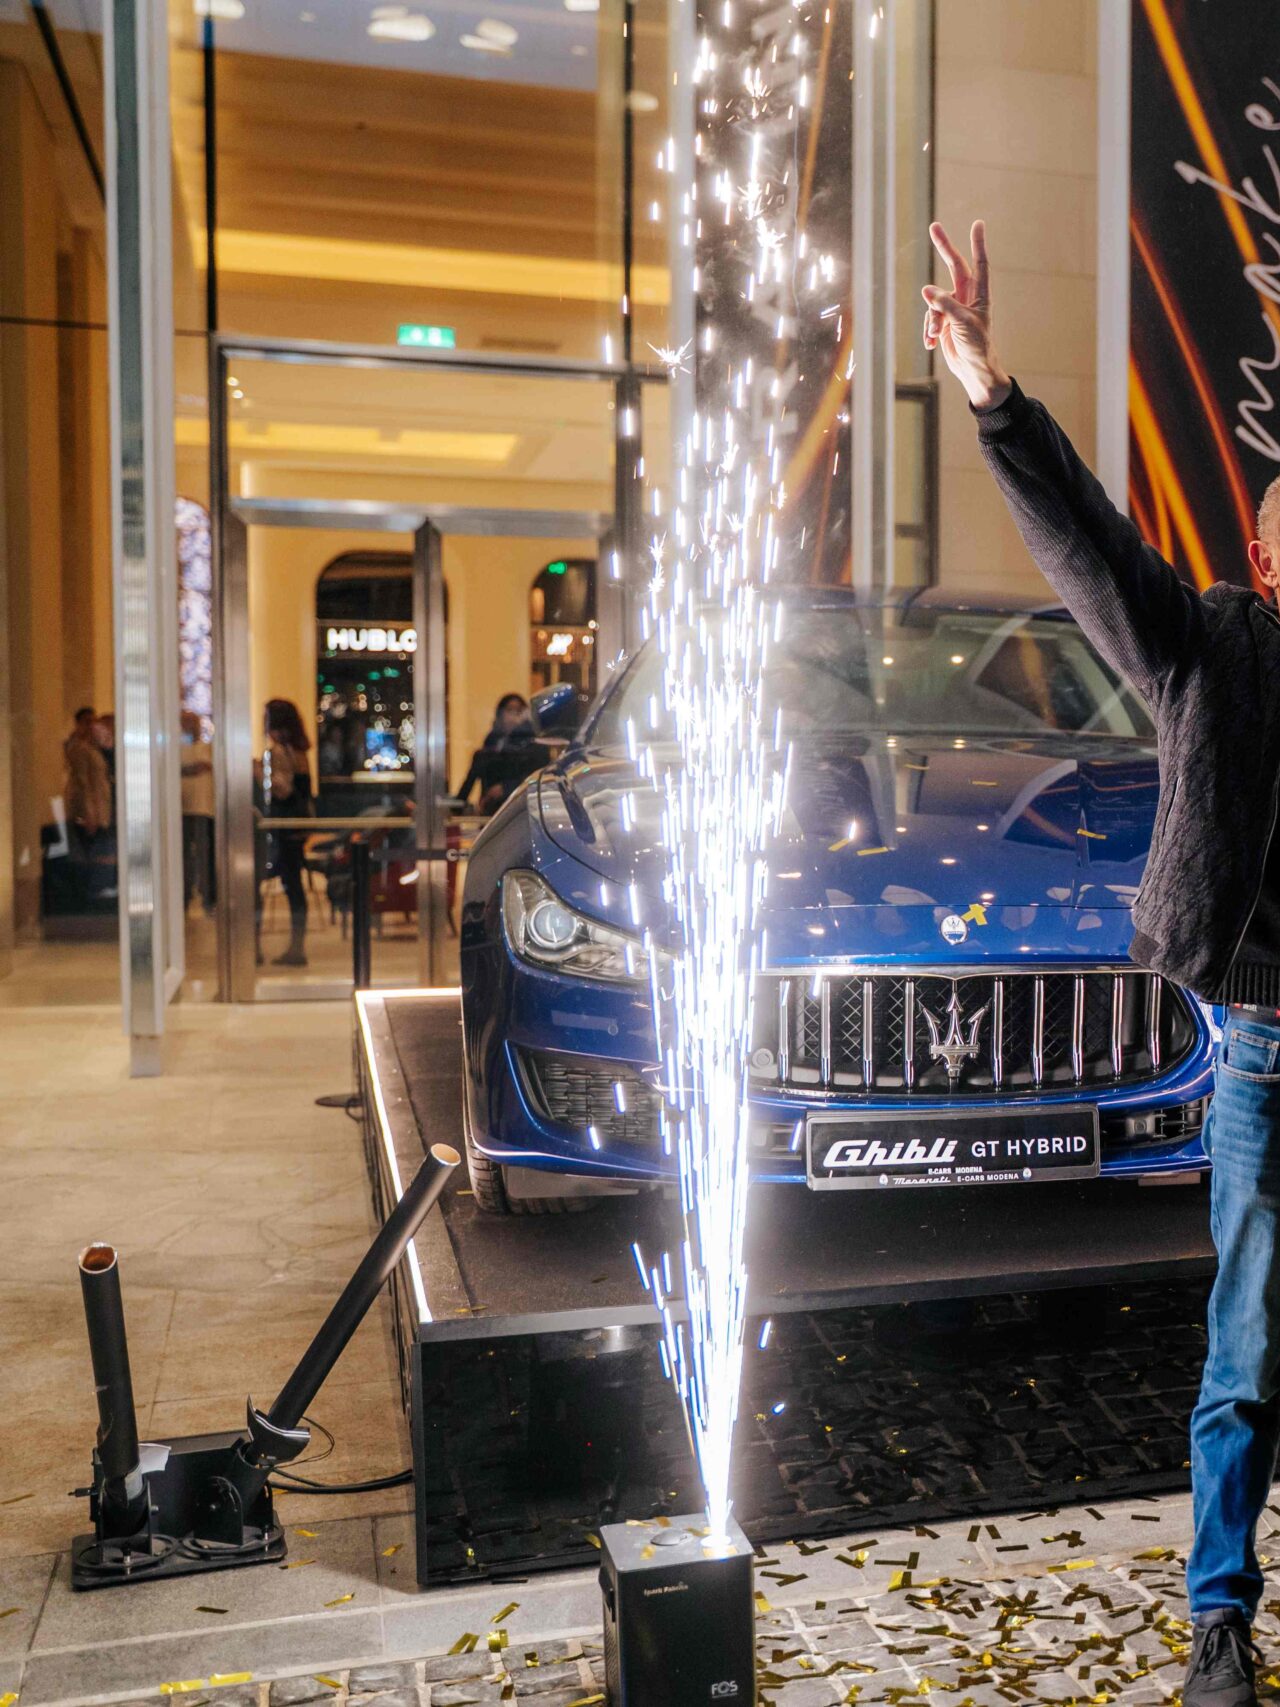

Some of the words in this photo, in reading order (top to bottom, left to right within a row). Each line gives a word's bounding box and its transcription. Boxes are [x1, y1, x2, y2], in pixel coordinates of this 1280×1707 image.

[823, 1137, 959, 1168] Ghibli
[971, 1140, 999, 1158] GT
[1007, 1136, 1087, 1156] HYBRID
[928, 1167, 952, 1175] E-CARS
[955, 1166, 983, 1174] MODENA
[957, 1174, 985, 1183] E-CARS
[987, 1173, 1019, 1181] MODENA
[711, 1680, 739, 1695] FOS
